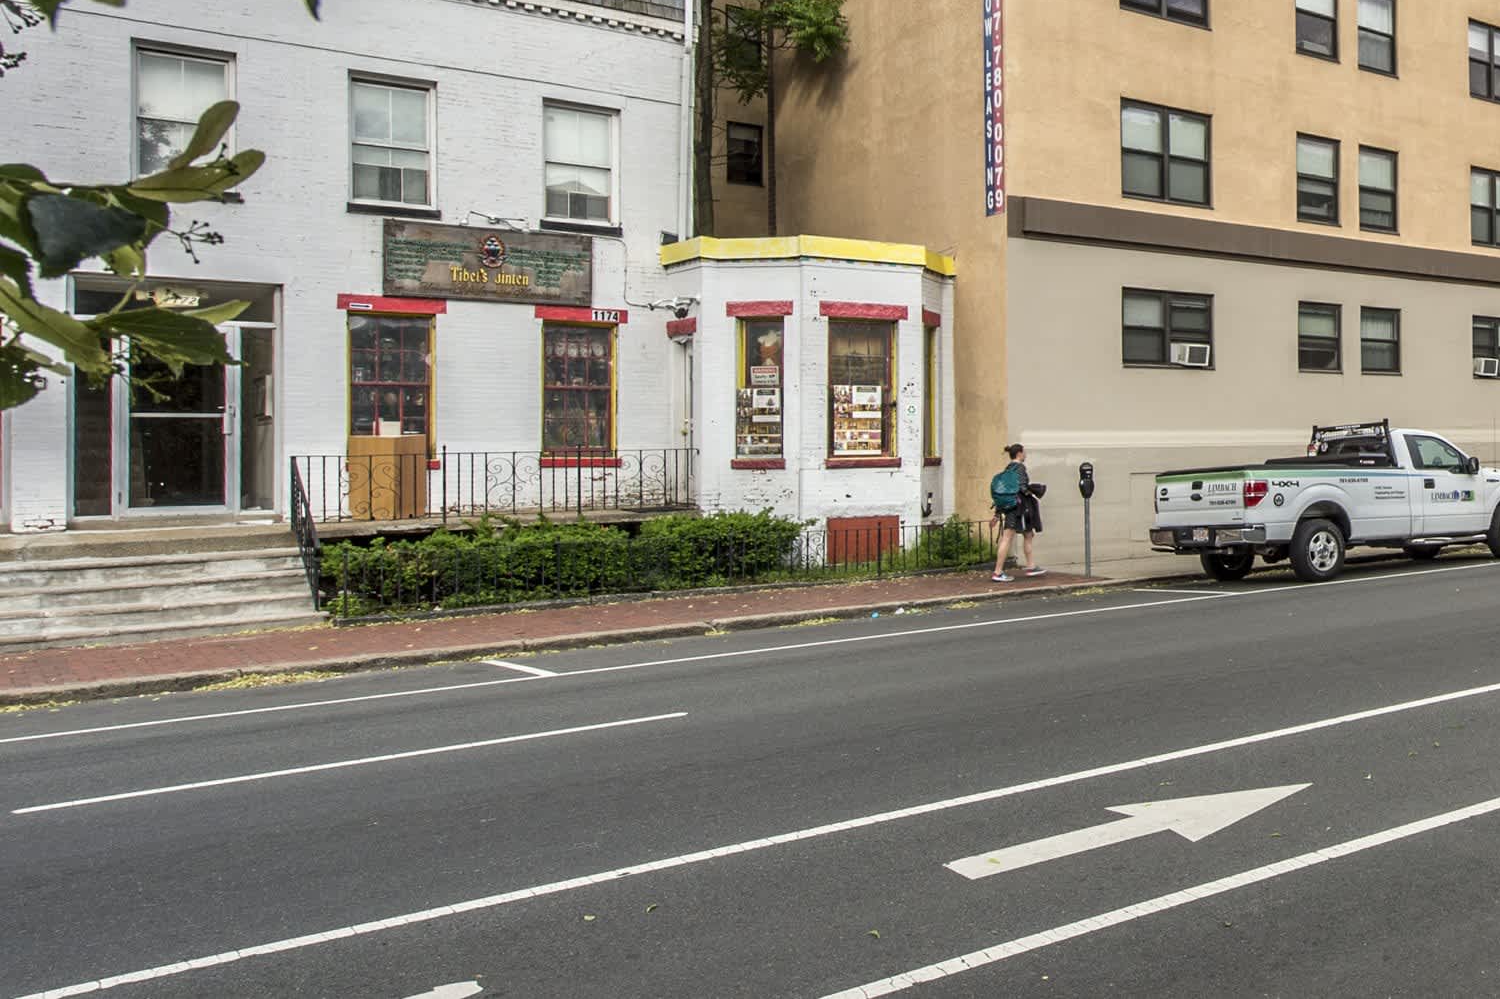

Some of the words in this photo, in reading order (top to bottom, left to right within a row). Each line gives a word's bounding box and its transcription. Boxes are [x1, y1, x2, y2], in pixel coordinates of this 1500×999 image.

[985, 49, 994, 209] LEASING
[594, 310, 618, 321] 1174
[1207, 482, 1237, 493] LIMBACH
